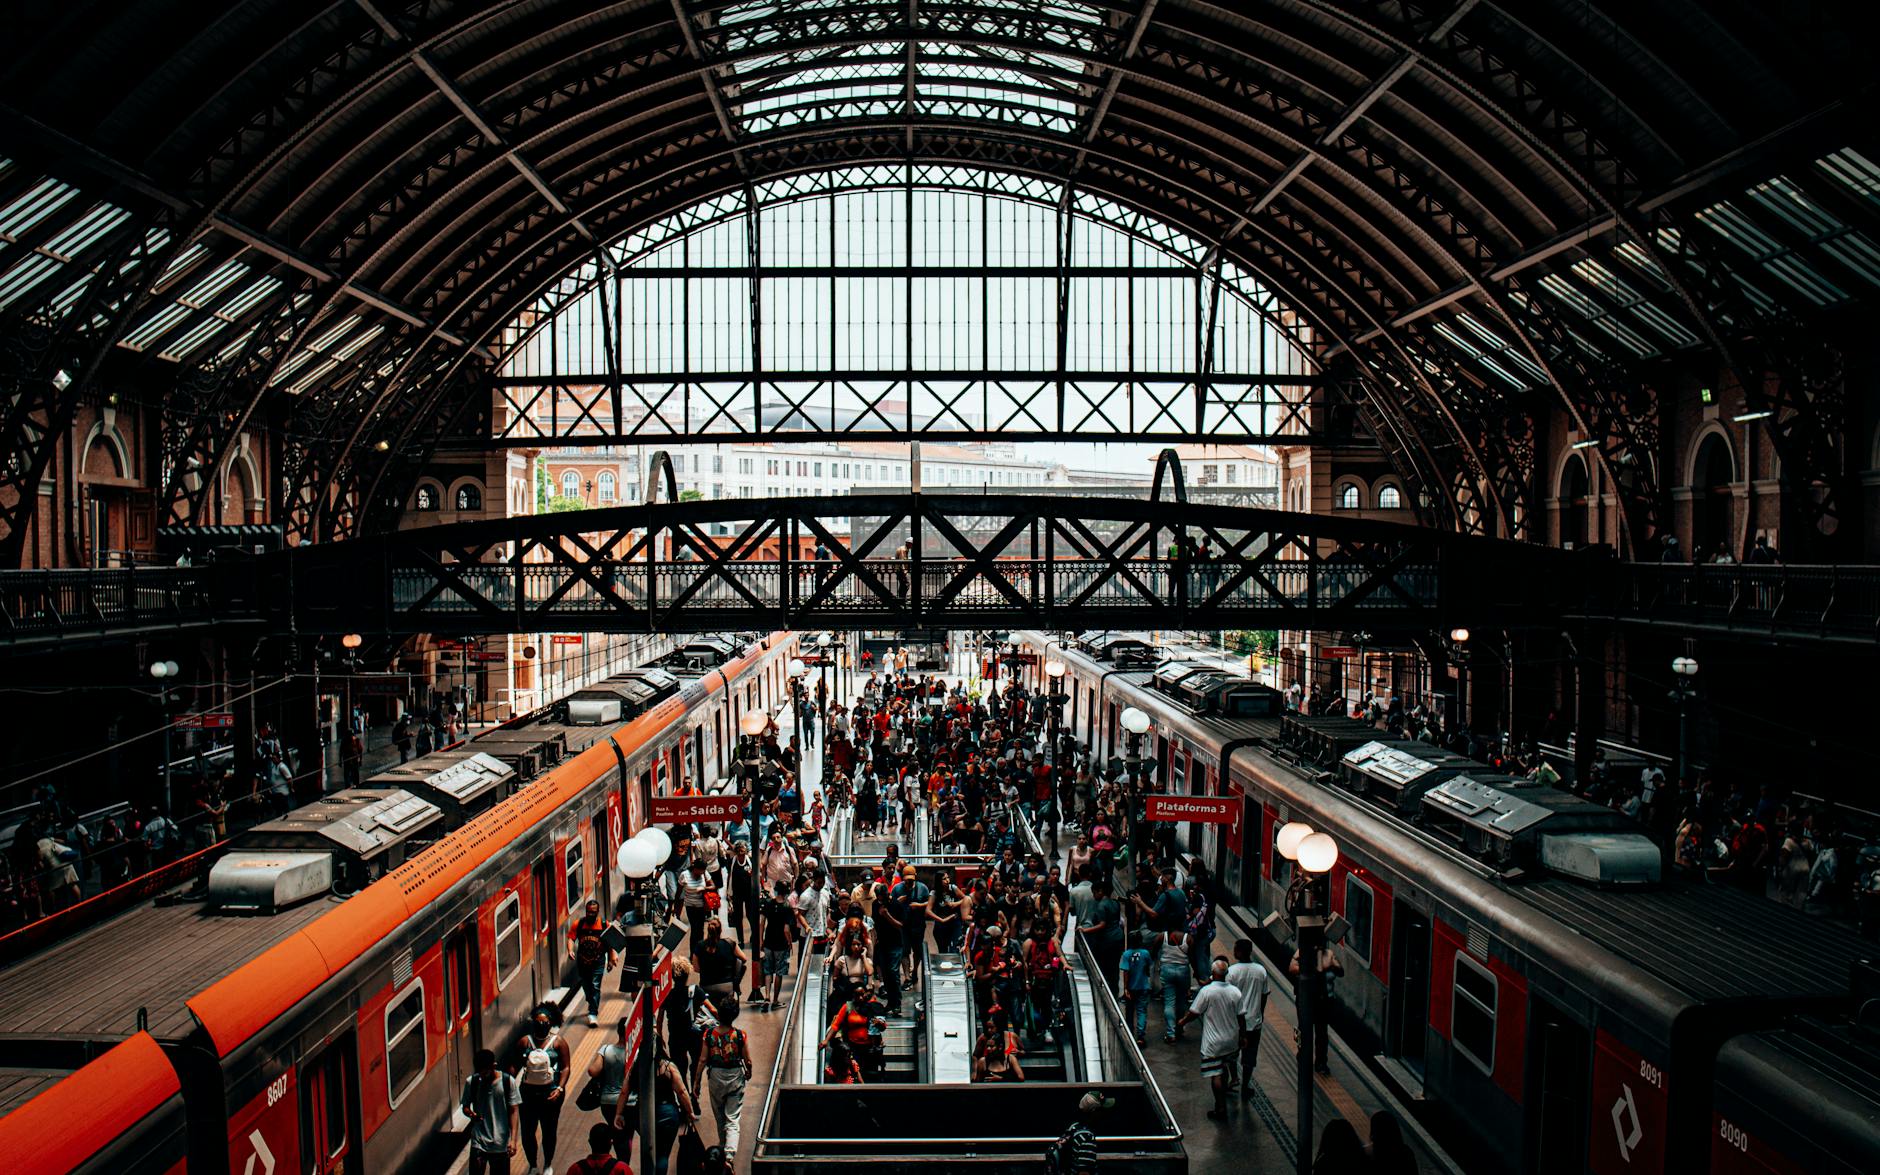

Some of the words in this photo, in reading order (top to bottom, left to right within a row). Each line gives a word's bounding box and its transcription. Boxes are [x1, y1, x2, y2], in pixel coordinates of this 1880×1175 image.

[690, 804, 725, 816] Saída
[1156, 802, 1217, 813] Plataforma
[1219, 805, 1226, 814] 3
[1640, 1059, 1662, 1089] 8091
[267, 1073, 287, 1107] 8607
[1720, 1119, 1748, 1153] 8090
